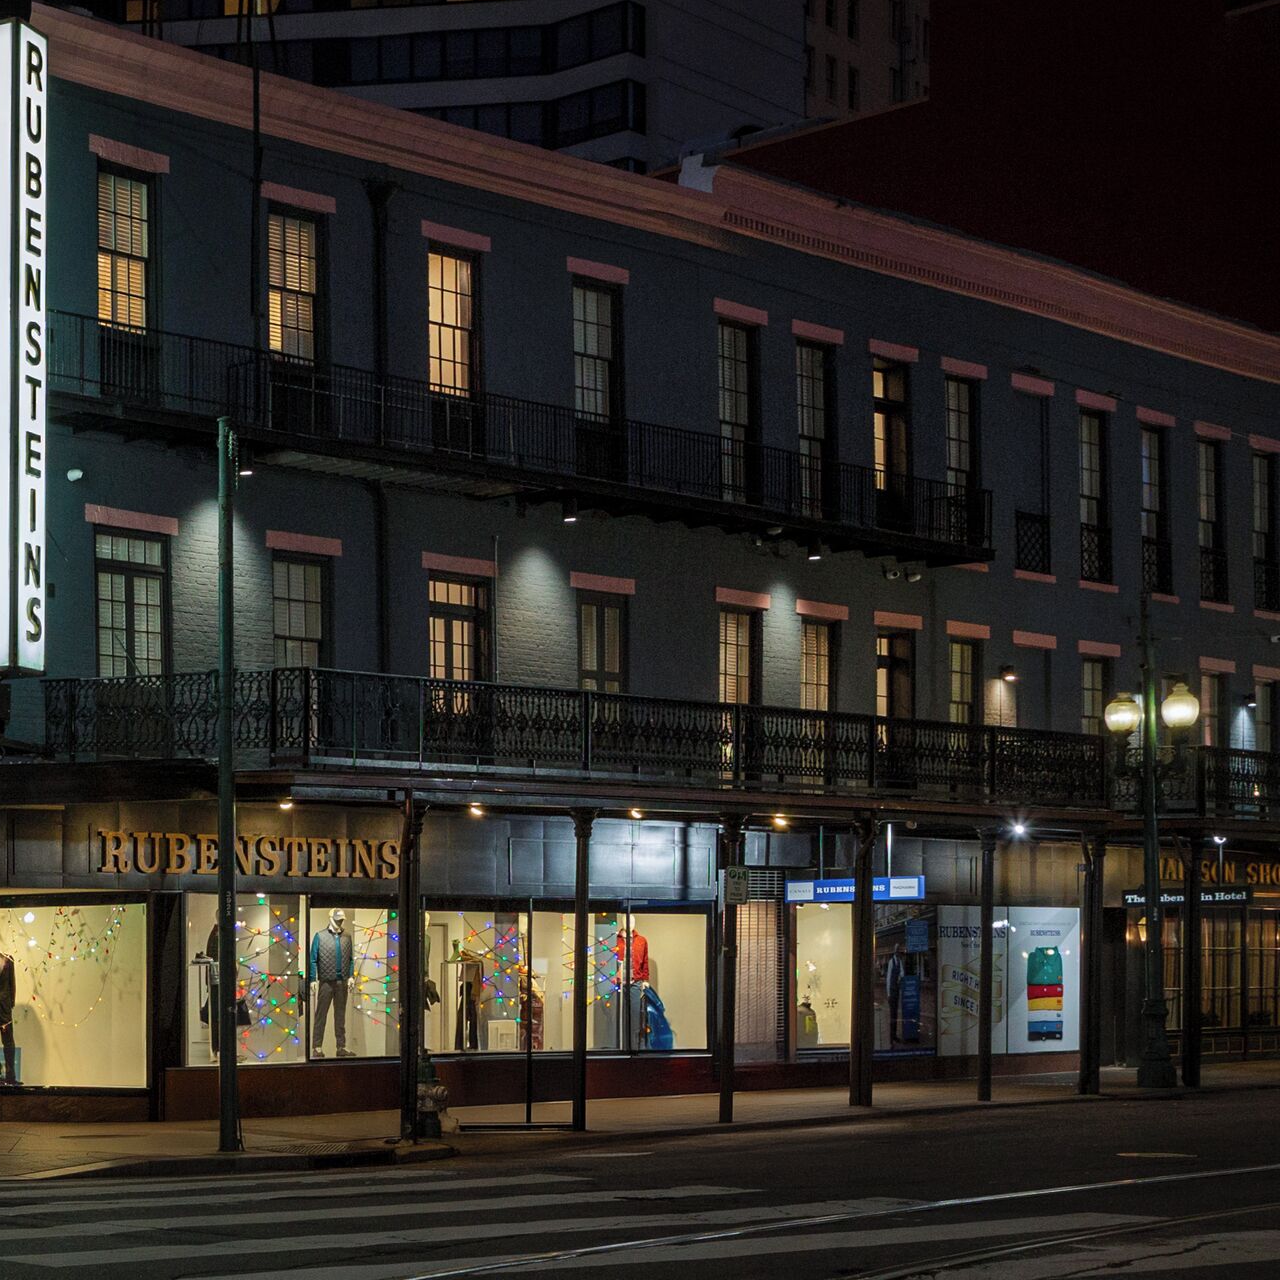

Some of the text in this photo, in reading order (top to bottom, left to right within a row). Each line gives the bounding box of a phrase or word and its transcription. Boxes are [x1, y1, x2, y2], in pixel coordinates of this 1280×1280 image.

[24, 40, 43, 643] RUBENSTEINS
[98, 829, 400, 880] RUBENSTEINS
[816, 884, 885, 894] RUBENSNS
[1214, 891, 1246, 901] Hotel
[952, 970, 973, 986] RIGHT
[953, 995, 975, 1012] SINCE
